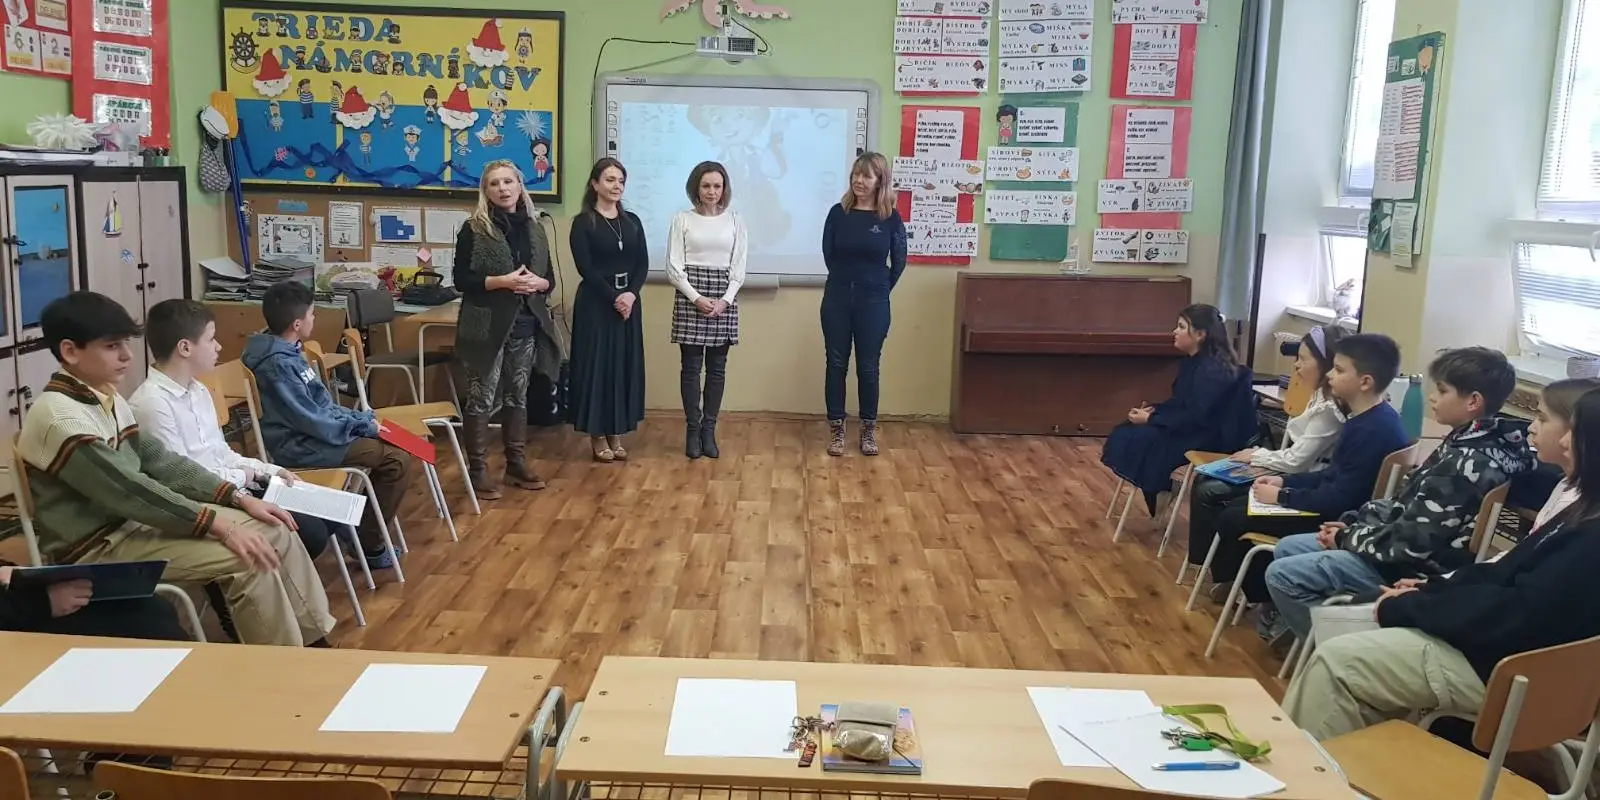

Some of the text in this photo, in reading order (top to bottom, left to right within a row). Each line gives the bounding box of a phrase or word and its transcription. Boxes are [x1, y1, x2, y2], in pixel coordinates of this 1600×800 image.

[252, 12, 401, 44] TRIEDA
[14, 31, 24, 50] 6
[50, 37, 59, 55] 2
